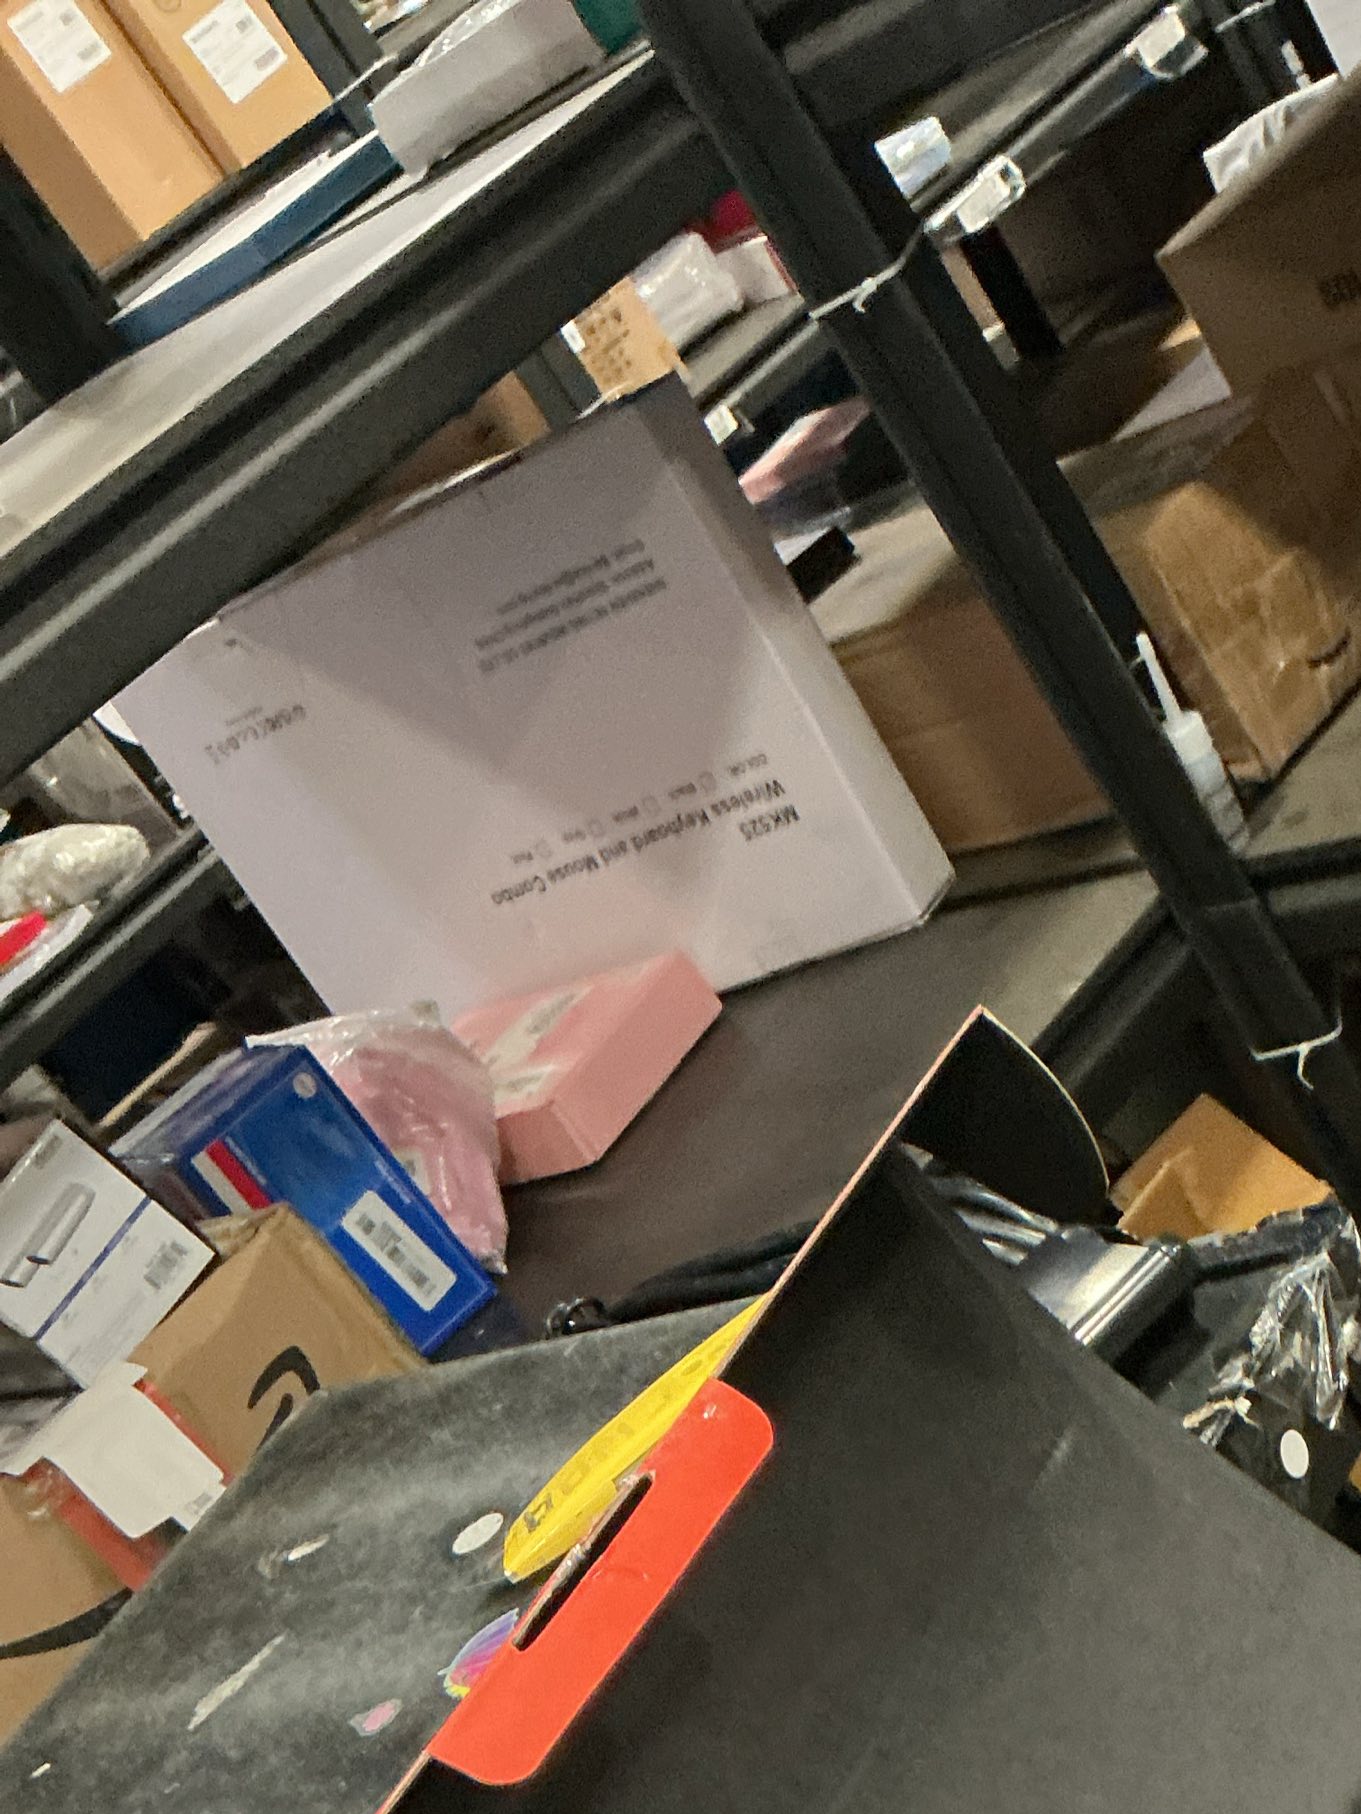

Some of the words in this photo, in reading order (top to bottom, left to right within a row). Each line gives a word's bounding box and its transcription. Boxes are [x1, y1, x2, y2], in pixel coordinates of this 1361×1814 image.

[710, 779, 787, 818] Wireless
[630, 808, 712, 855] Keyboard
[546, 853, 601, 886] Mouse
[597, 839, 629, 868] and
[490, 874, 548, 906] Combo
